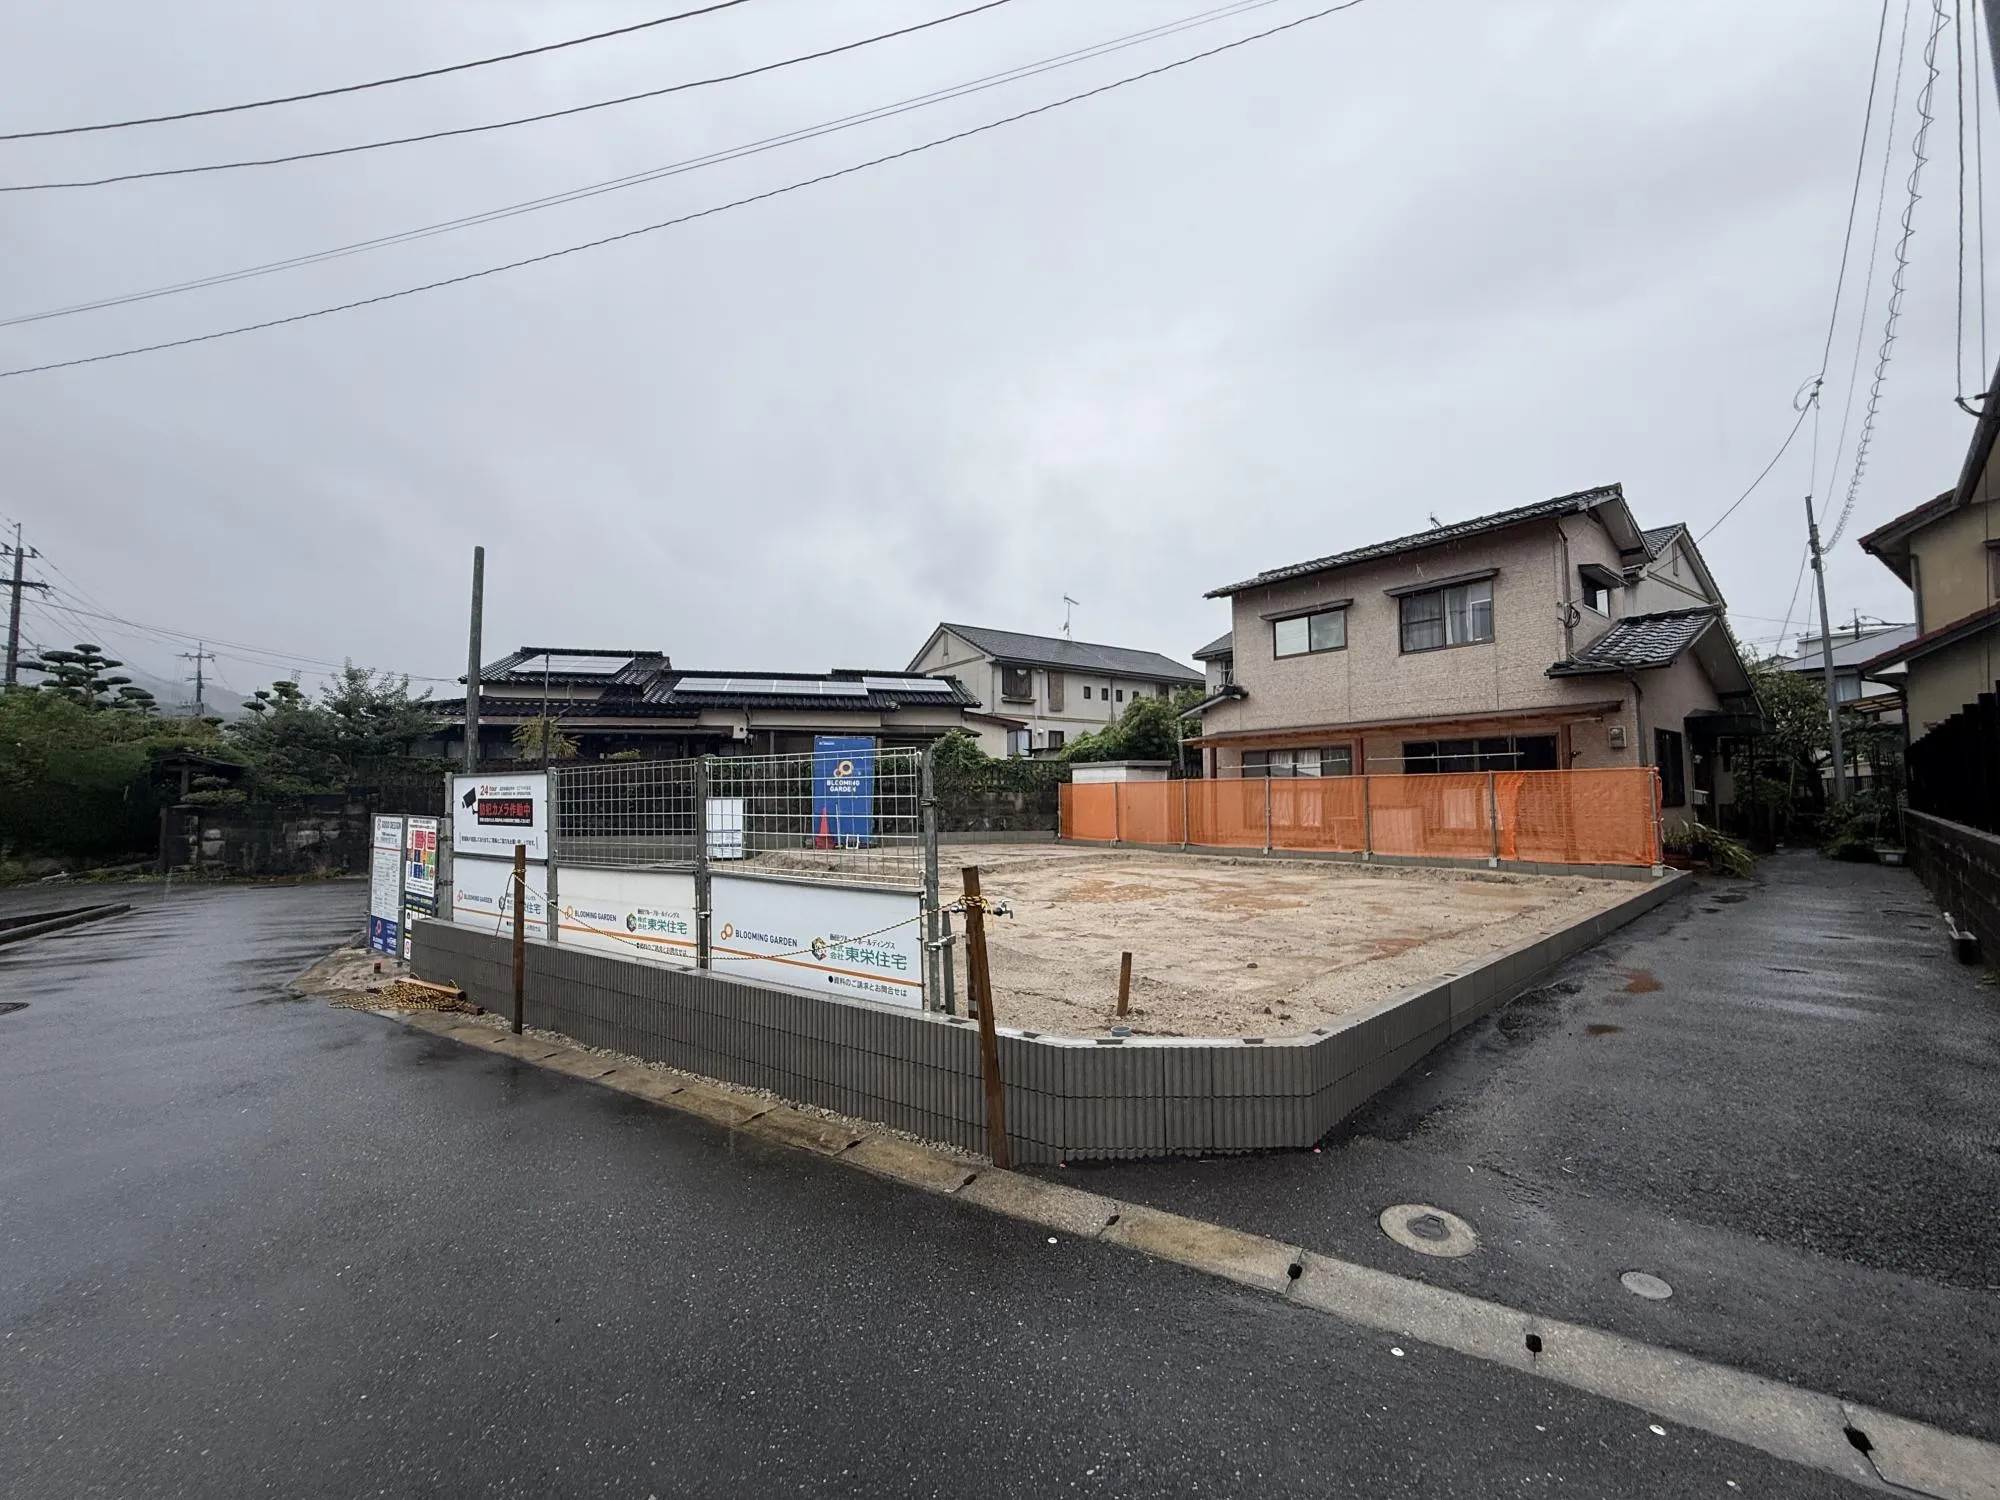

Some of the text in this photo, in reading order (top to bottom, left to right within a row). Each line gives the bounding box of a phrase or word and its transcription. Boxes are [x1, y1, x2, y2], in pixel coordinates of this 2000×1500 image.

[480, 785, 489, 796] 24
[479, 802, 531, 817] 防犯カメラ作動中
[574, 909, 617, 922] BLOOMING GARDEN
[647, 918, 688, 935] 東栄住宅
[735, 929, 798, 948] BLOOMING GARDEN
[845, 946, 908, 971] 東栄住宅
[833, 976, 908, 997] 資料のご請求とお問合せは
